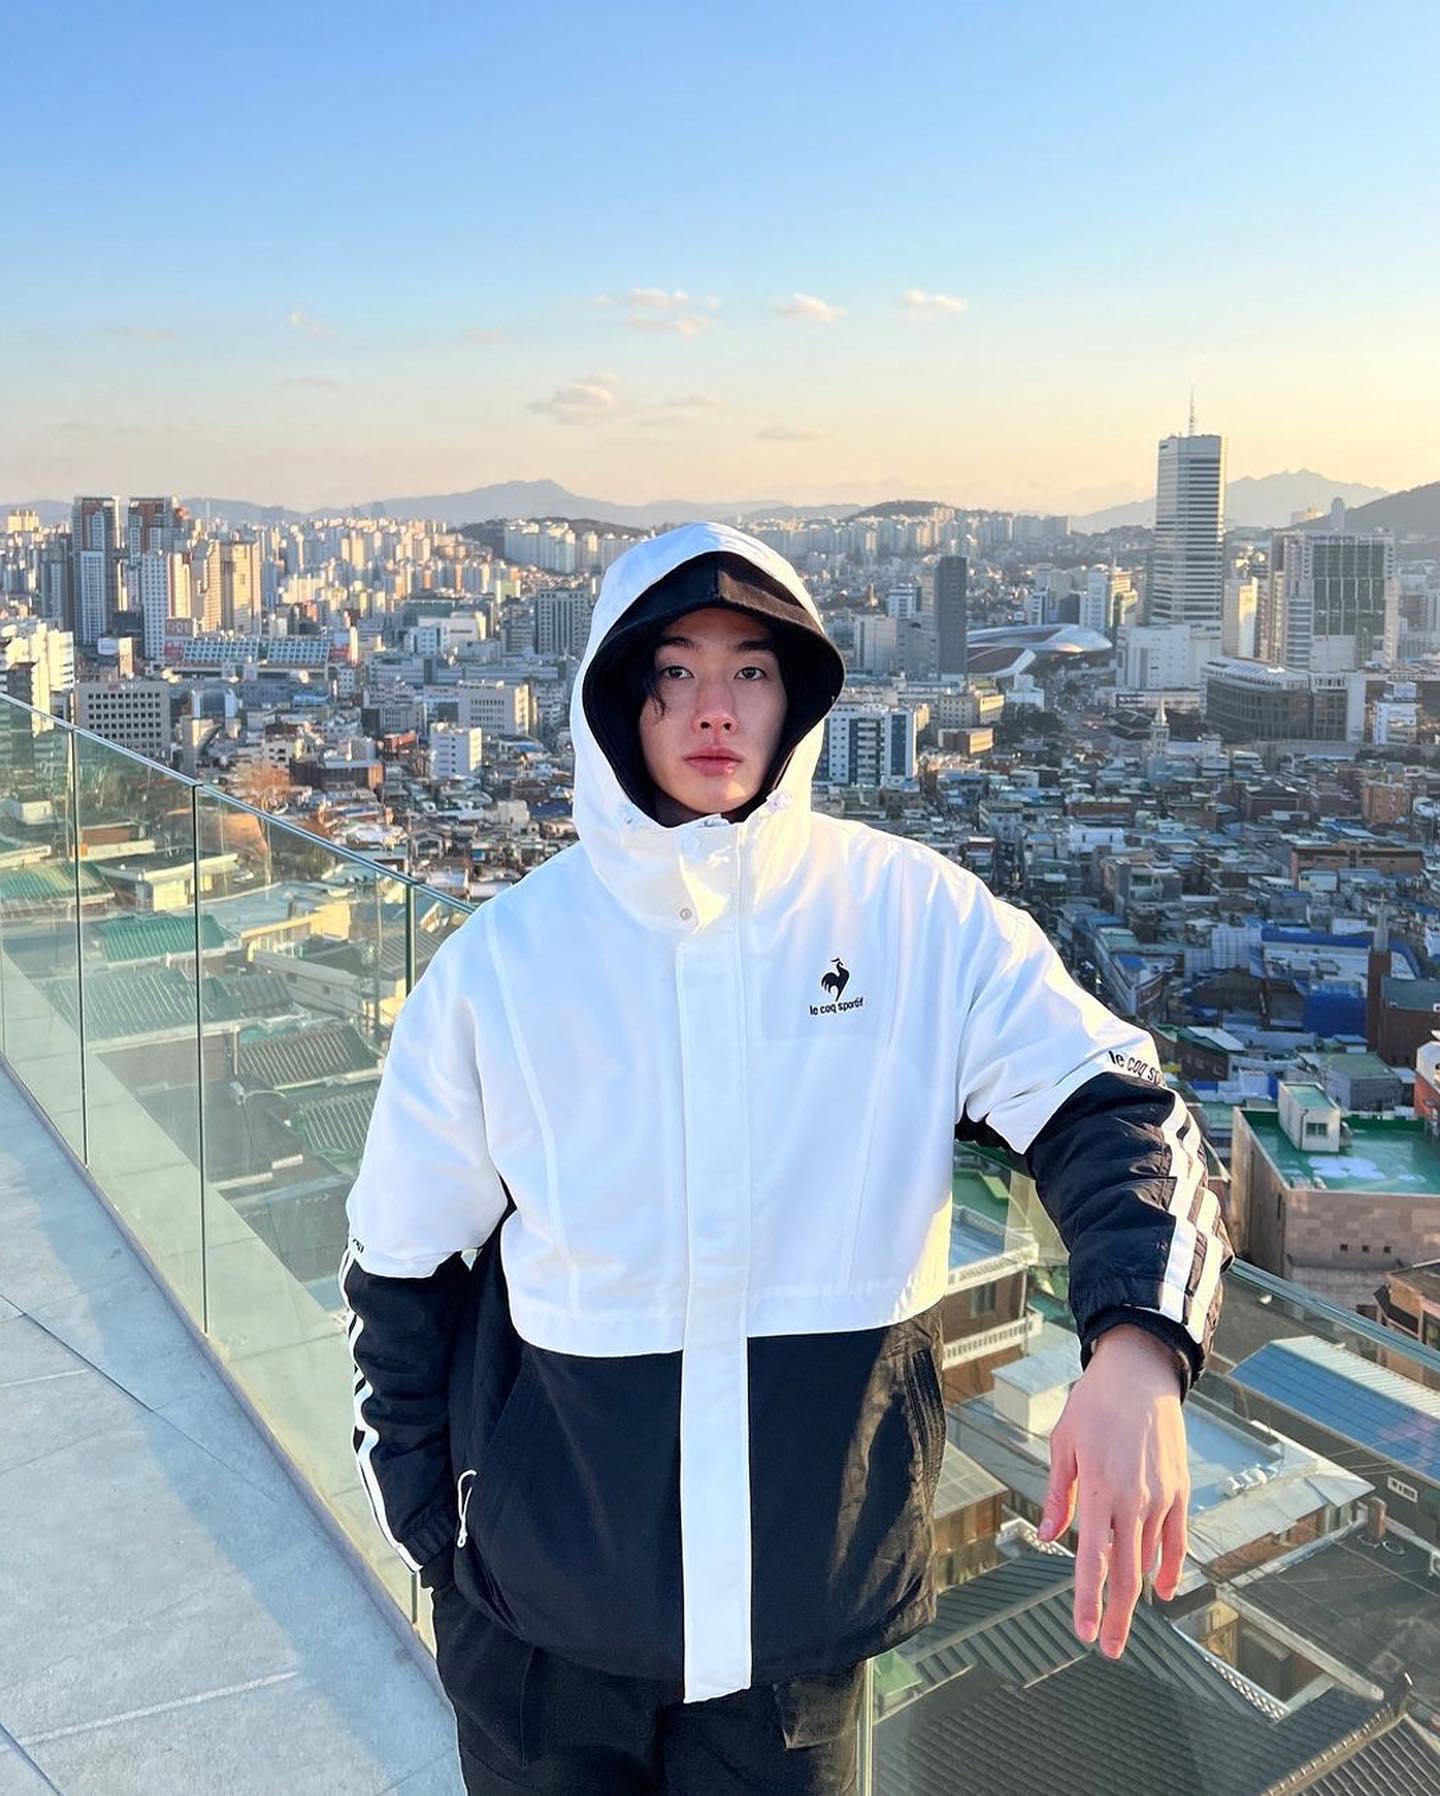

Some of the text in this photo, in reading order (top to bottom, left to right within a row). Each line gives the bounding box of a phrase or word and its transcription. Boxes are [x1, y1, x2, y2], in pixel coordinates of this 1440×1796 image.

[809, 1005, 818, 1015] le
[820, 1003, 837, 1014] coq
[1108, 1050, 1125, 1067] le
[1127, 1057, 1148, 1078] coq
